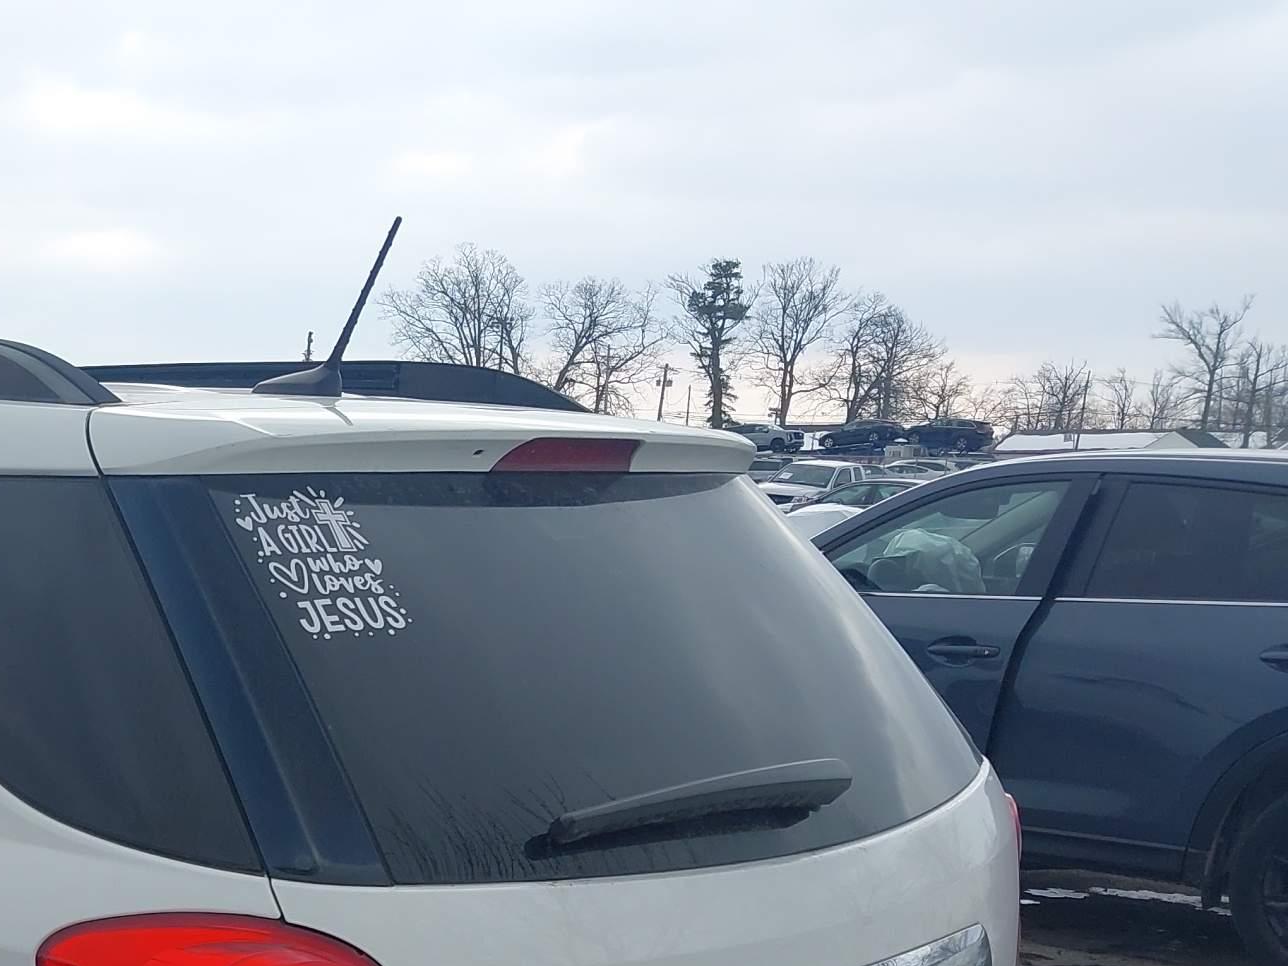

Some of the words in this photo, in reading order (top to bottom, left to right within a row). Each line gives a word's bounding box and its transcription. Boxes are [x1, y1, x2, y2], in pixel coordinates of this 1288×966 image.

[240, 494, 310, 523] Just
[258, 527, 282, 556] A
[277, 525, 337, 553] GIRL
[307, 554, 363, 574] who
[312, 573, 384, 595] loves
[297, 596, 406, 633] JESUS
